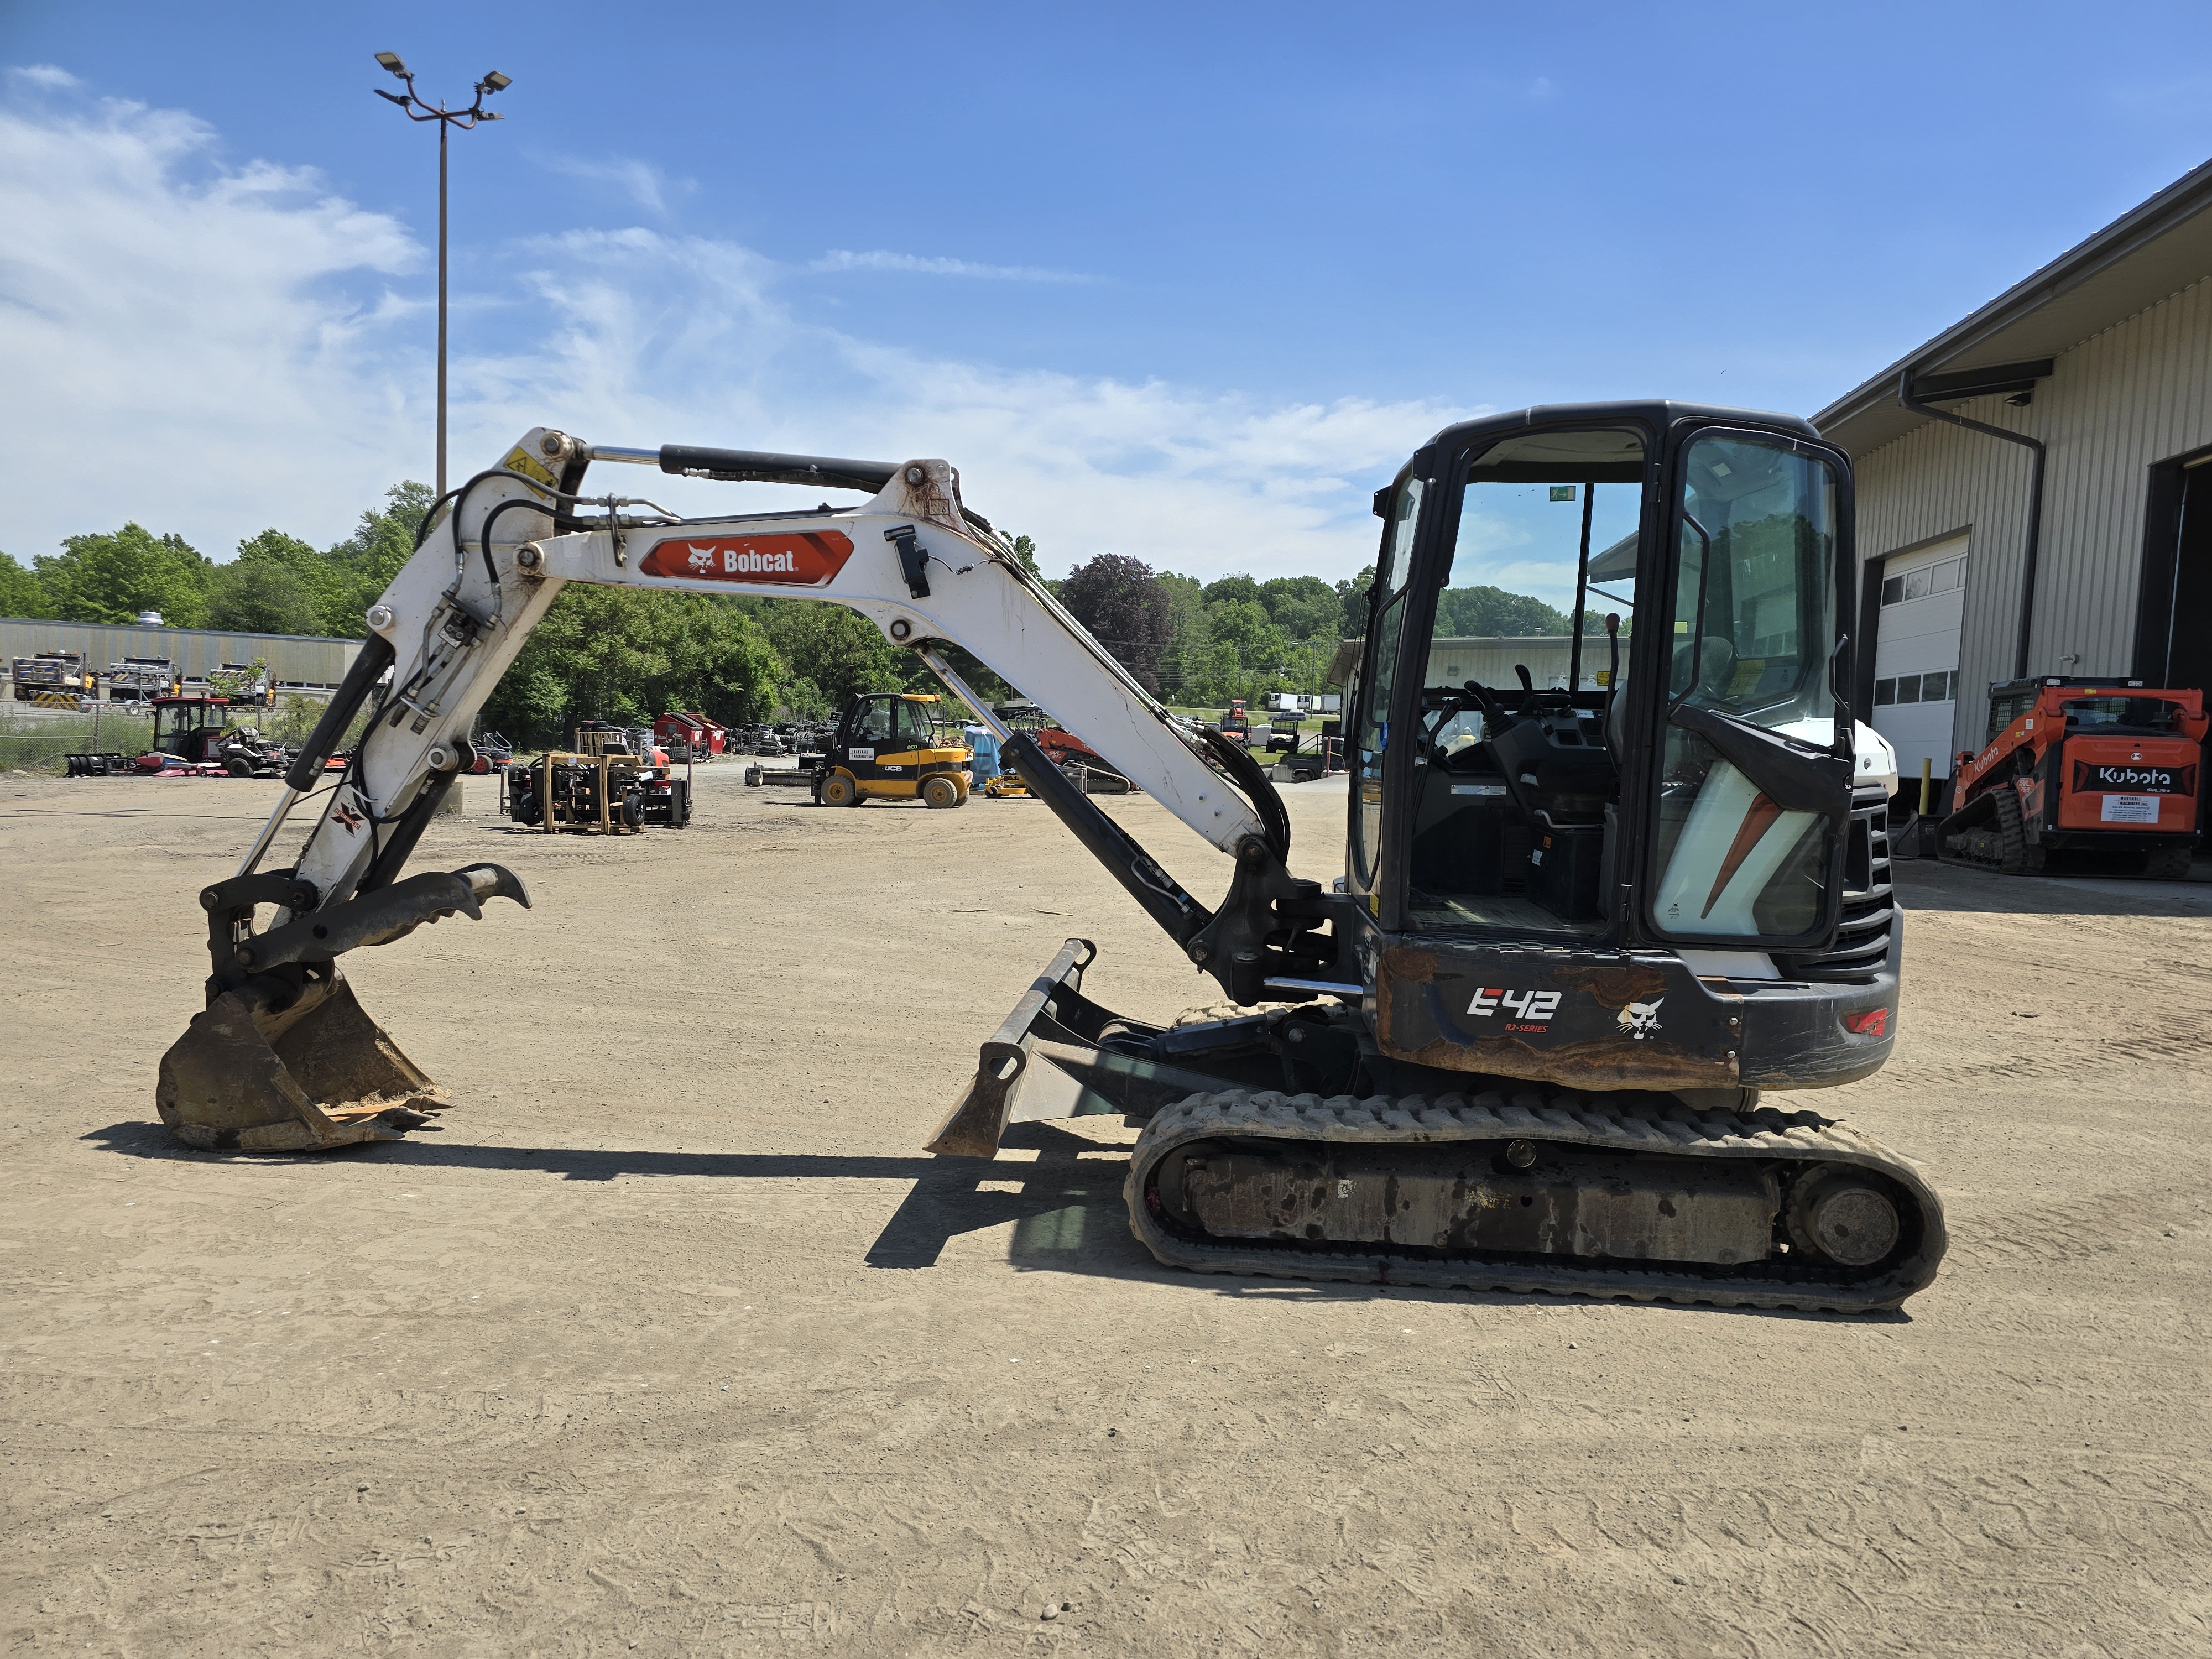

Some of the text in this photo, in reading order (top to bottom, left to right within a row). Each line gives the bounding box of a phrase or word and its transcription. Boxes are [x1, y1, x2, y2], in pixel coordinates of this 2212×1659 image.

[724, 550, 794, 572] Bobcat
[1974, 747, 1999, 773] Kubota
[2099, 767, 2171, 785] Kubota
[334, 807, 361, 829] HYDRAULIC
[1467, 987, 1562, 1020] E42
[1504, 1023, 1548, 1033] R2-SERIES
